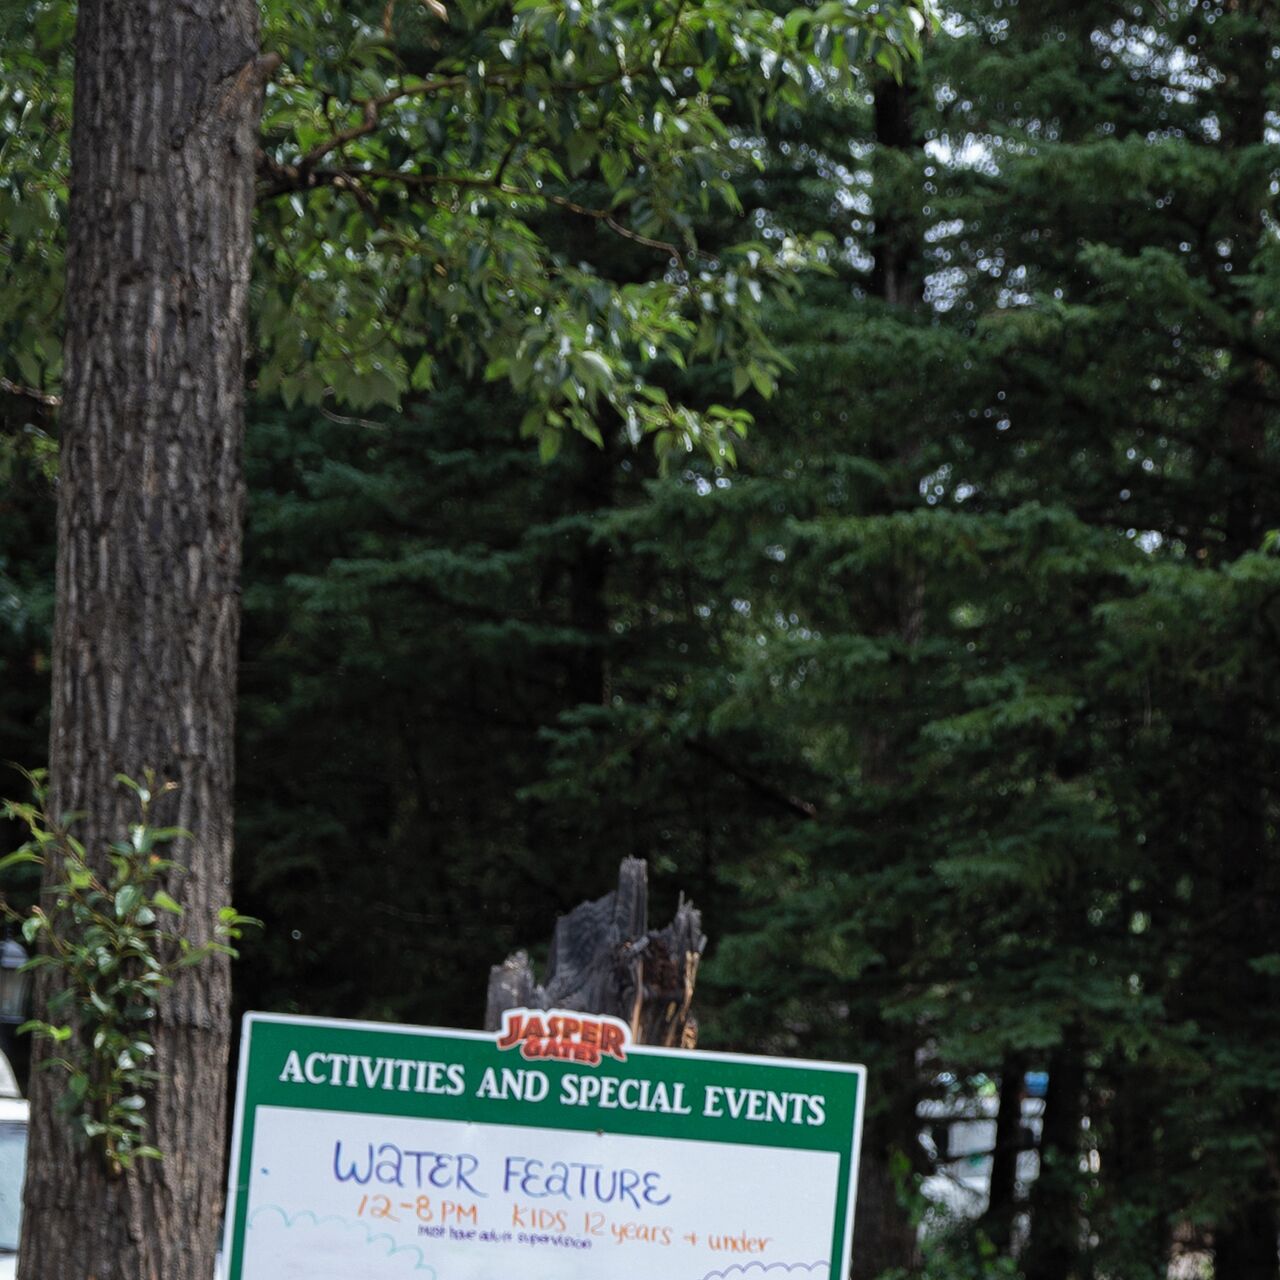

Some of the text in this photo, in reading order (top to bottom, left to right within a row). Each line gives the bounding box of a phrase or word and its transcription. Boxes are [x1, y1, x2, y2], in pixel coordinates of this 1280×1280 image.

[498, 1014, 627, 1060] JASPER
[523, 1037, 601, 1065] GATES
[279, 1050, 826, 1127] ACTIVITIES AND SPECIAL EVENTS
[441, 1200, 478, 1226] PM
[511, 1203, 568, 1233] KIDS
[584, 1211, 606, 1236] 12
[610, 1220, 673, 1246] years
[708, 1230, 773, 1254] under
